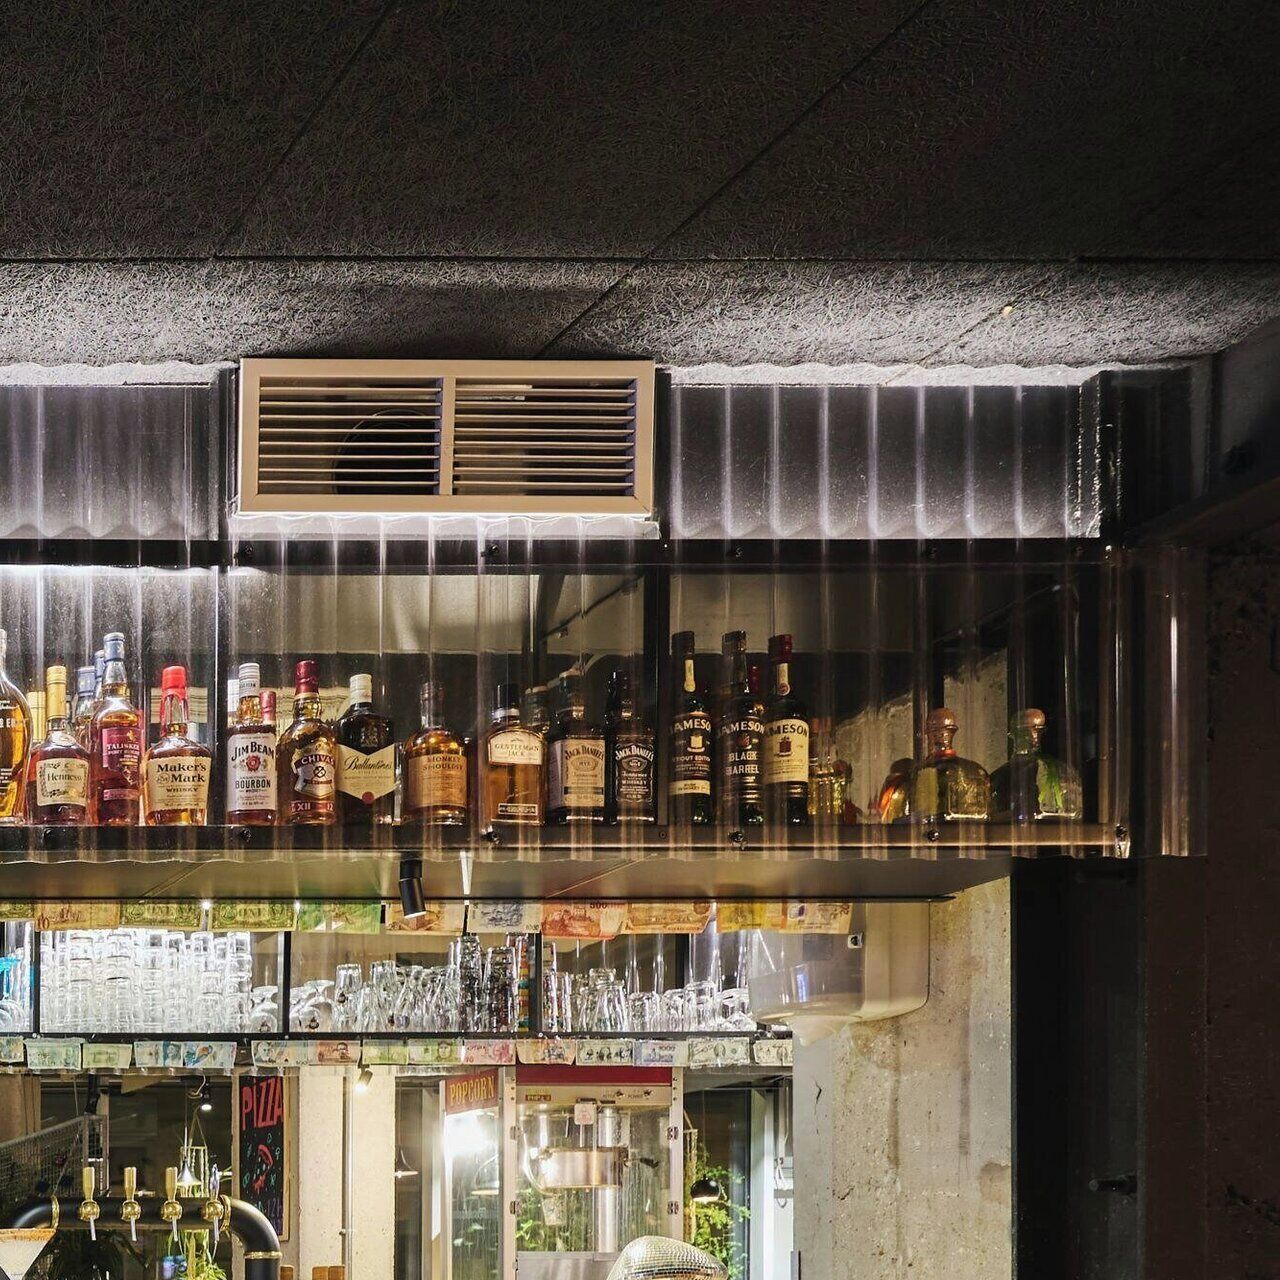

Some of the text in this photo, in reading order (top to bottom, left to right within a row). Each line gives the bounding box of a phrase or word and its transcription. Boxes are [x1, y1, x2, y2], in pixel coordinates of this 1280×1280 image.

[232, 741, 275, 761] JIM BEAM
[615, 748, 632, 760] JACK
[301, 755, 335, 766] CHIVAS
[157, 763, 206, 773] Maker's
[171, 773, 205, 783] Mark
[235, 780, 271, 789] BOURBON
[450, 1075, 496, 1107] POPCORN
